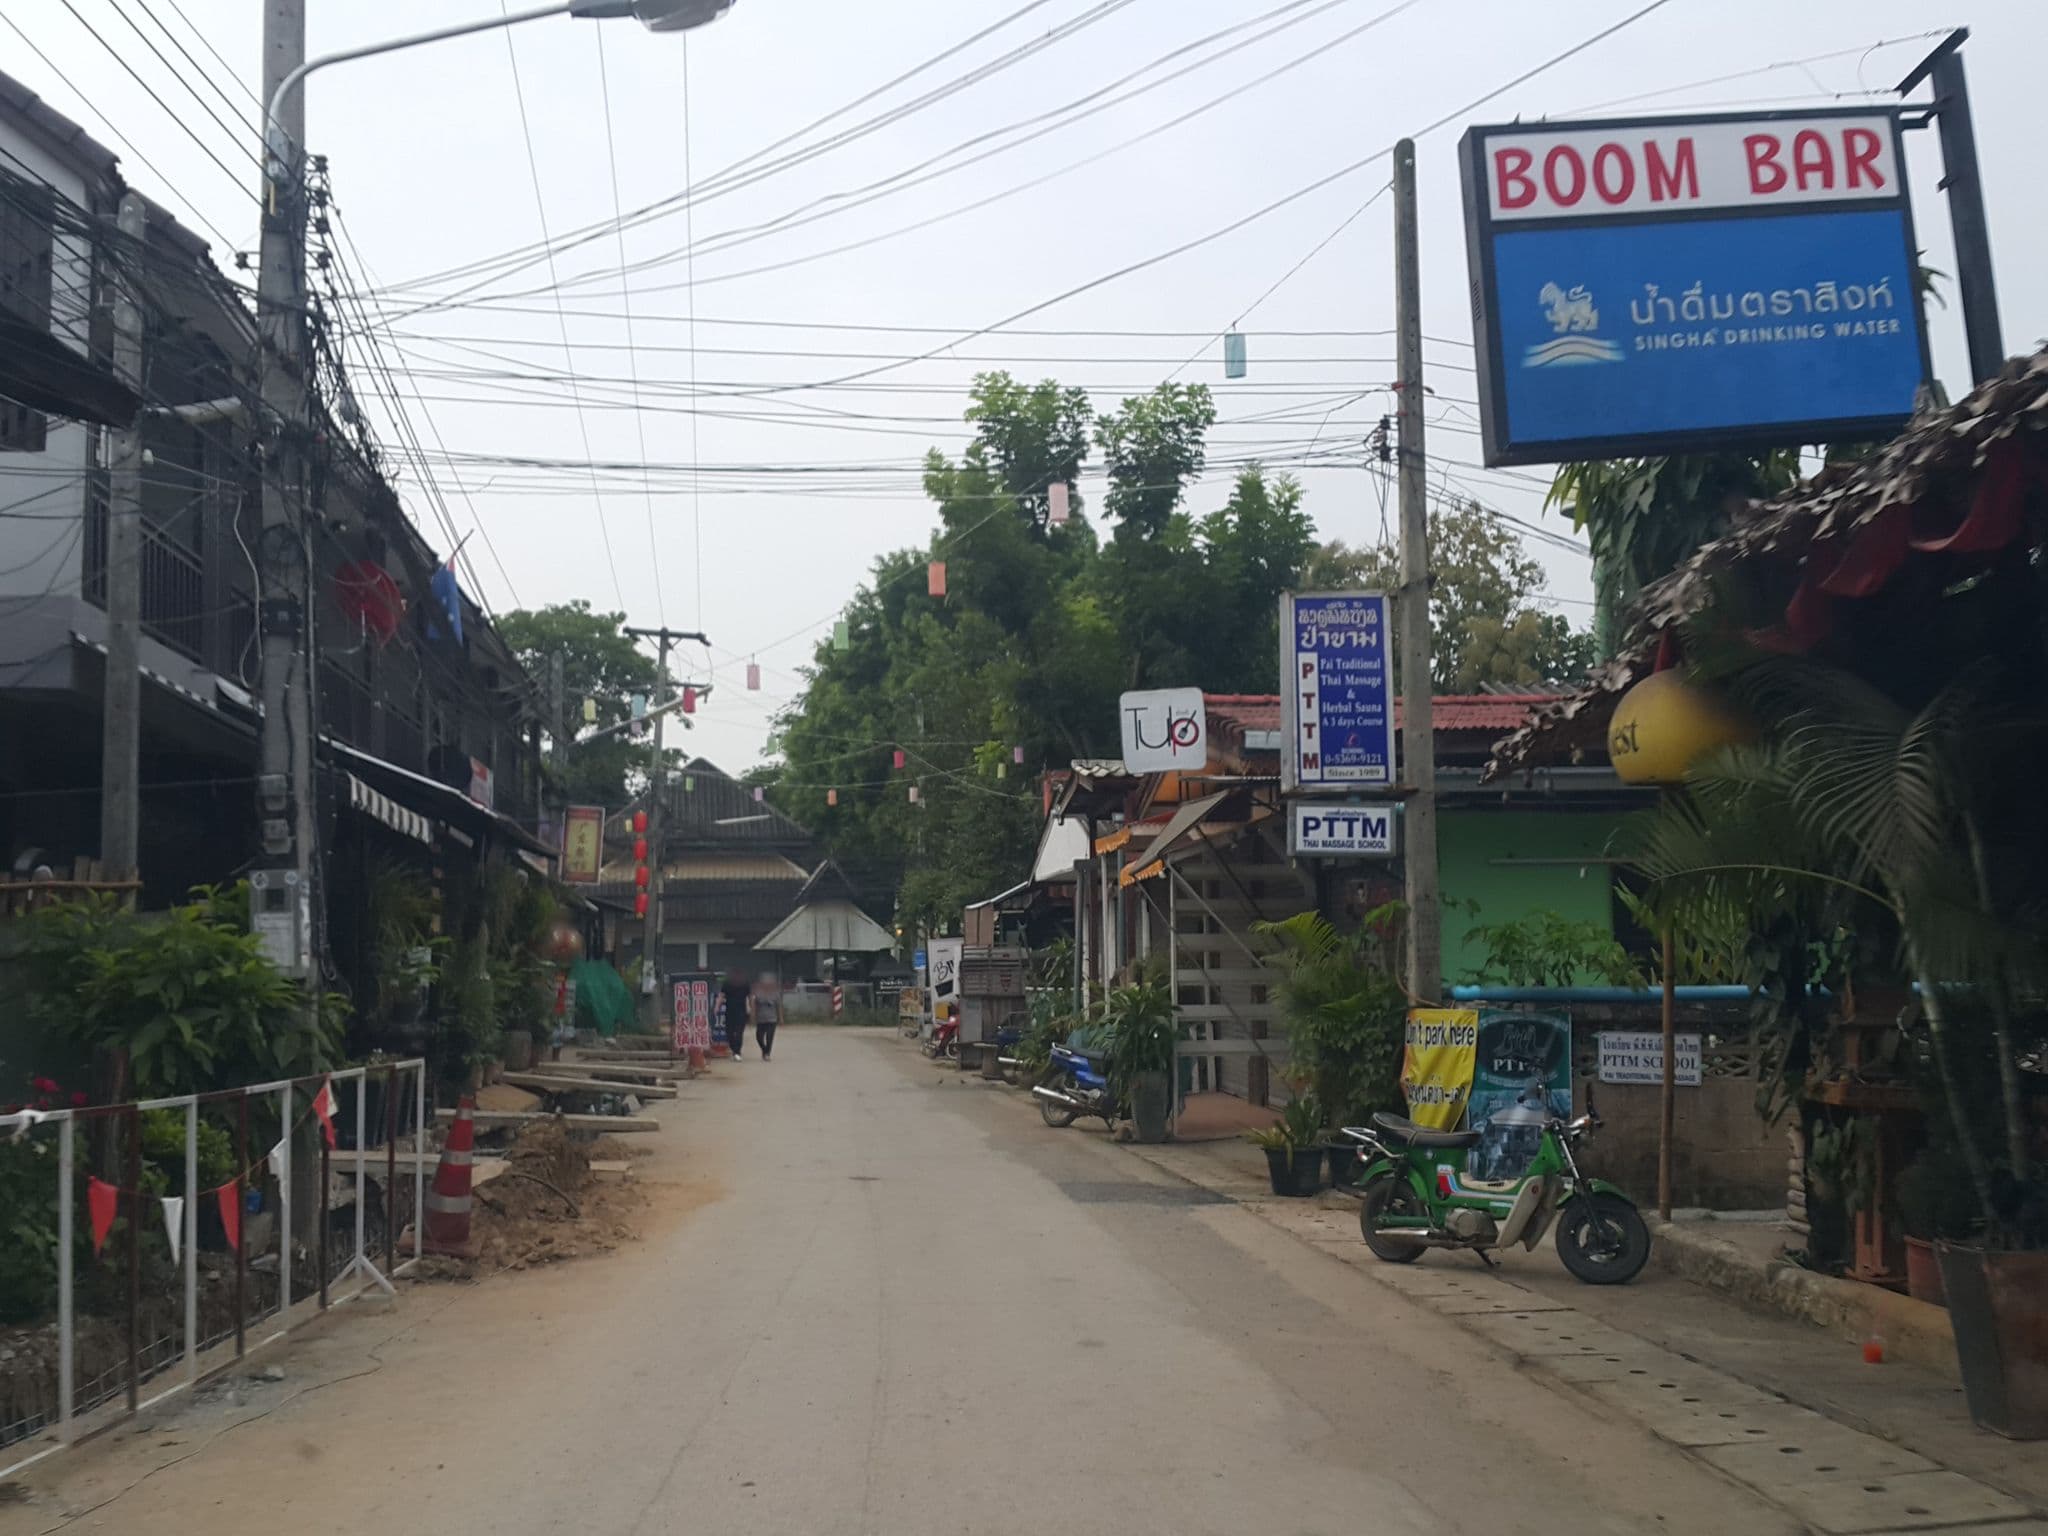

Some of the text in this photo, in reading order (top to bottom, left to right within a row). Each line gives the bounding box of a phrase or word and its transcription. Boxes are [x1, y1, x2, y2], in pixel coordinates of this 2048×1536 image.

[1494, 127, 1887, 210] BOOM BAR
[1629, 276, 1895, 326] น้ำดื่มตราสิงห์
[1634, 317, 1902, 352] SINGHA DRINKING WATER
[1300, 625, 1378, 648] ป่าขาม
[1320, 657, 1381, 670] Pai Traditional
[1320, 673, 1382, 688] Thai Massage
[1346, 688, 1356, 699] &
[1322, 702, 1383, 713] Herbal Sauna
[1302, 663, 1319, 769] PTTM
[1337, 716, 1355, 728] days
[1357, 716, 1384, 726] Course
[1328, 768, 1356, 777] Since
[1303, 816, 1387, 838] PTTM
[1303, 839, 1387, 849] THAI MASSAGE SCHOOL
[1425, 1019, 1448, 1051] park
[1449, 1019, 1475, 1046] here
[1602, 1054, 1639, 1067] PTTM
